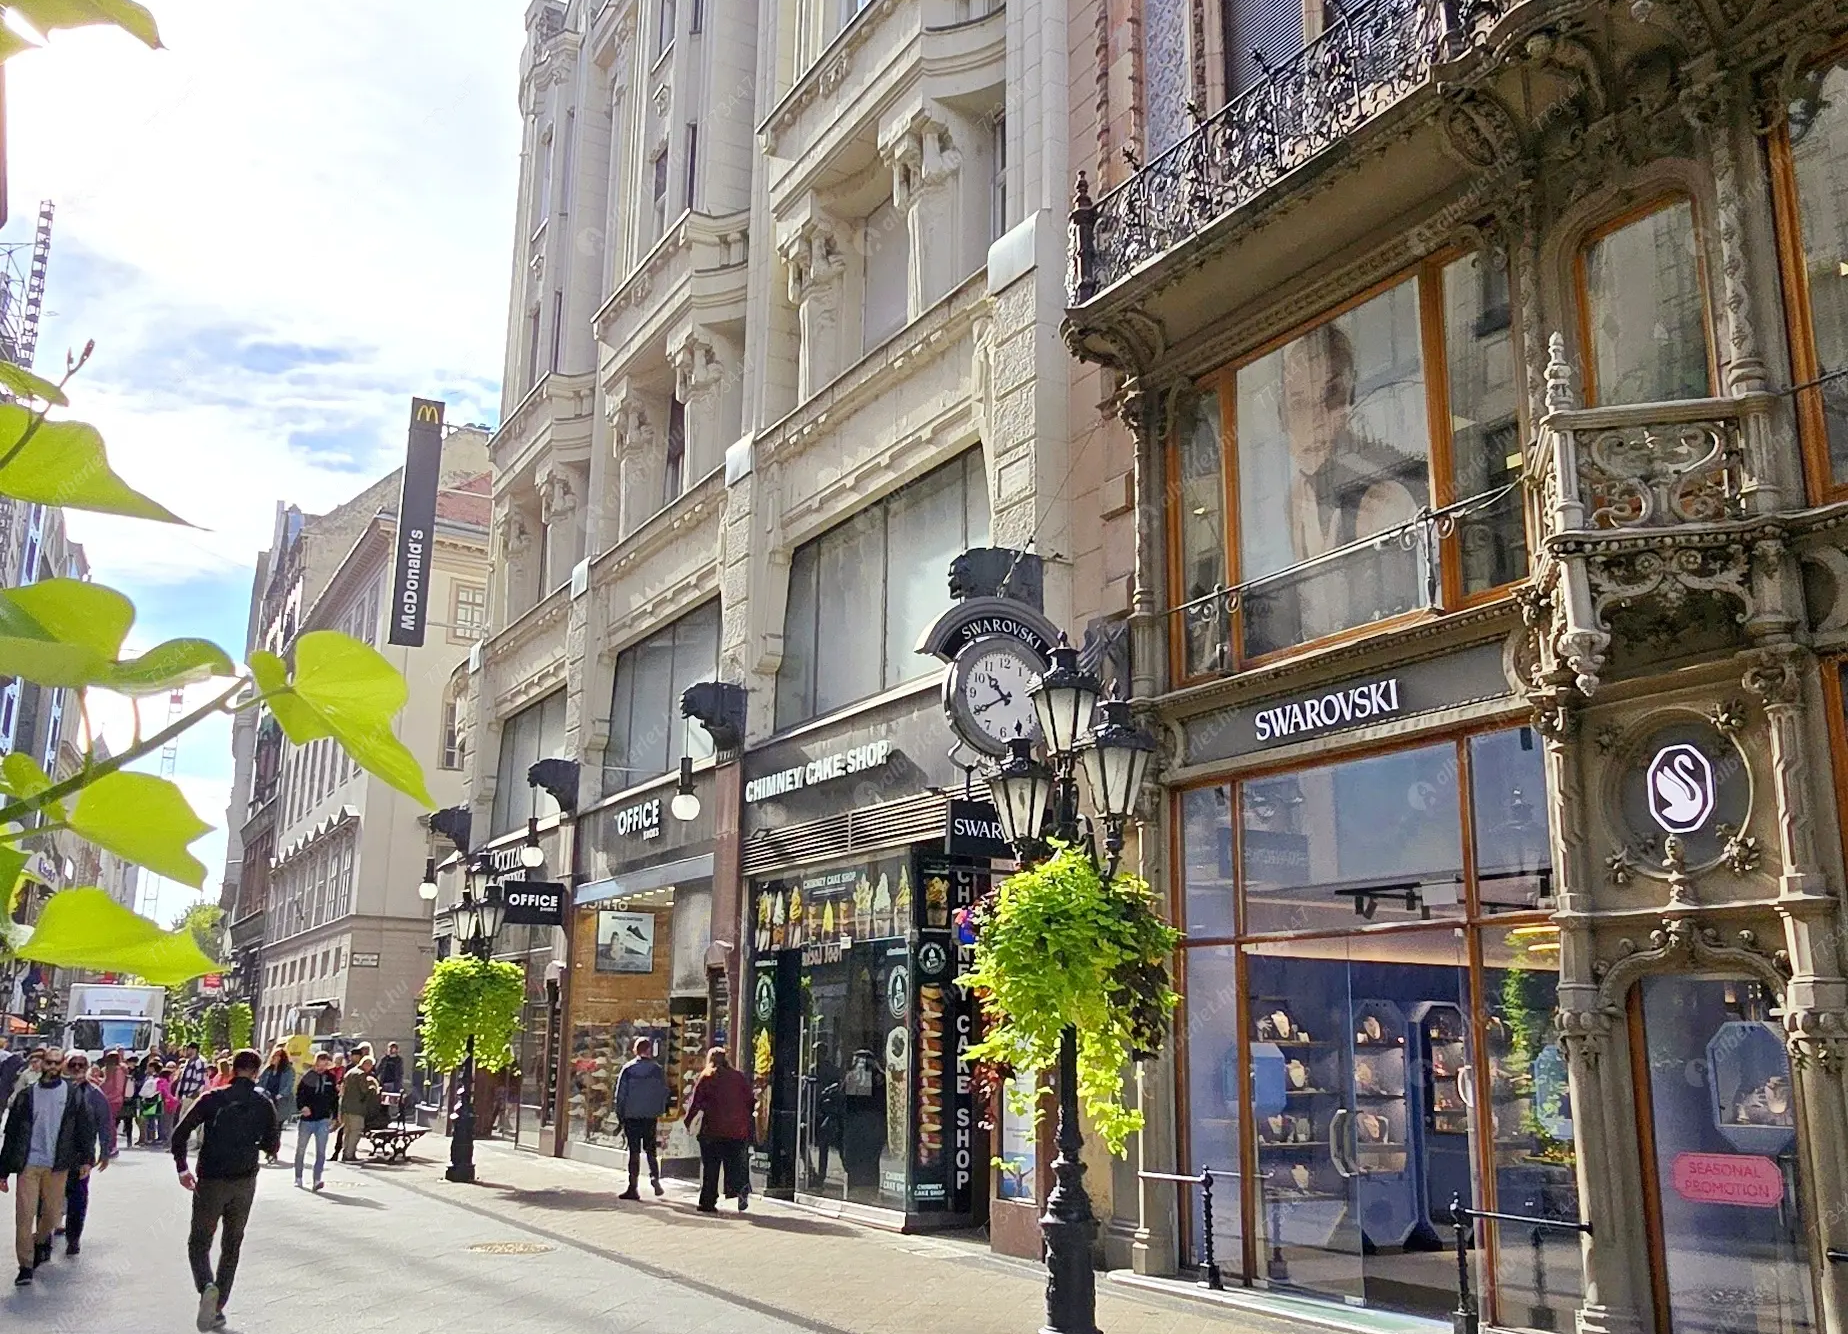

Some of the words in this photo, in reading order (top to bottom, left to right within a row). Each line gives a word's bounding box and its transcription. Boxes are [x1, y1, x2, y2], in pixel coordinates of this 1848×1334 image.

[401, 529, 424, 631] McDonald's
[962, 619, 1041, 649] SWAROVSKI
[984, 660, 993, 672] 11
[1000, 658, 1011, 669] 12
[974, 672, 985, 683] 10
[1018, 667, 1022, 677] 1
[969, 687, 977, 698] 9
[1255, 678, 1399, 741] SWAROVSKI
[984, 719, 991, 730] 7
[1026, 713, 1032, 724] 4
[1000, 726, 1007, 738] 6
[745, 766, 805, 803] CHIMNEY
[805, 753, 846, 785] CAKE
[847, 740, 892, 773] SHOP
[617, 798, 660, 836] OFFICE
[508, 893, 558, 907] OFFICE
[957, 1015, 970, 1094] CAKE
[957, 1109, 970, 1189] SHOP
[1689, 1161, 1762, 1179] SEASONAL
[1684, 1179, 1770, 1198] PROMOTION
